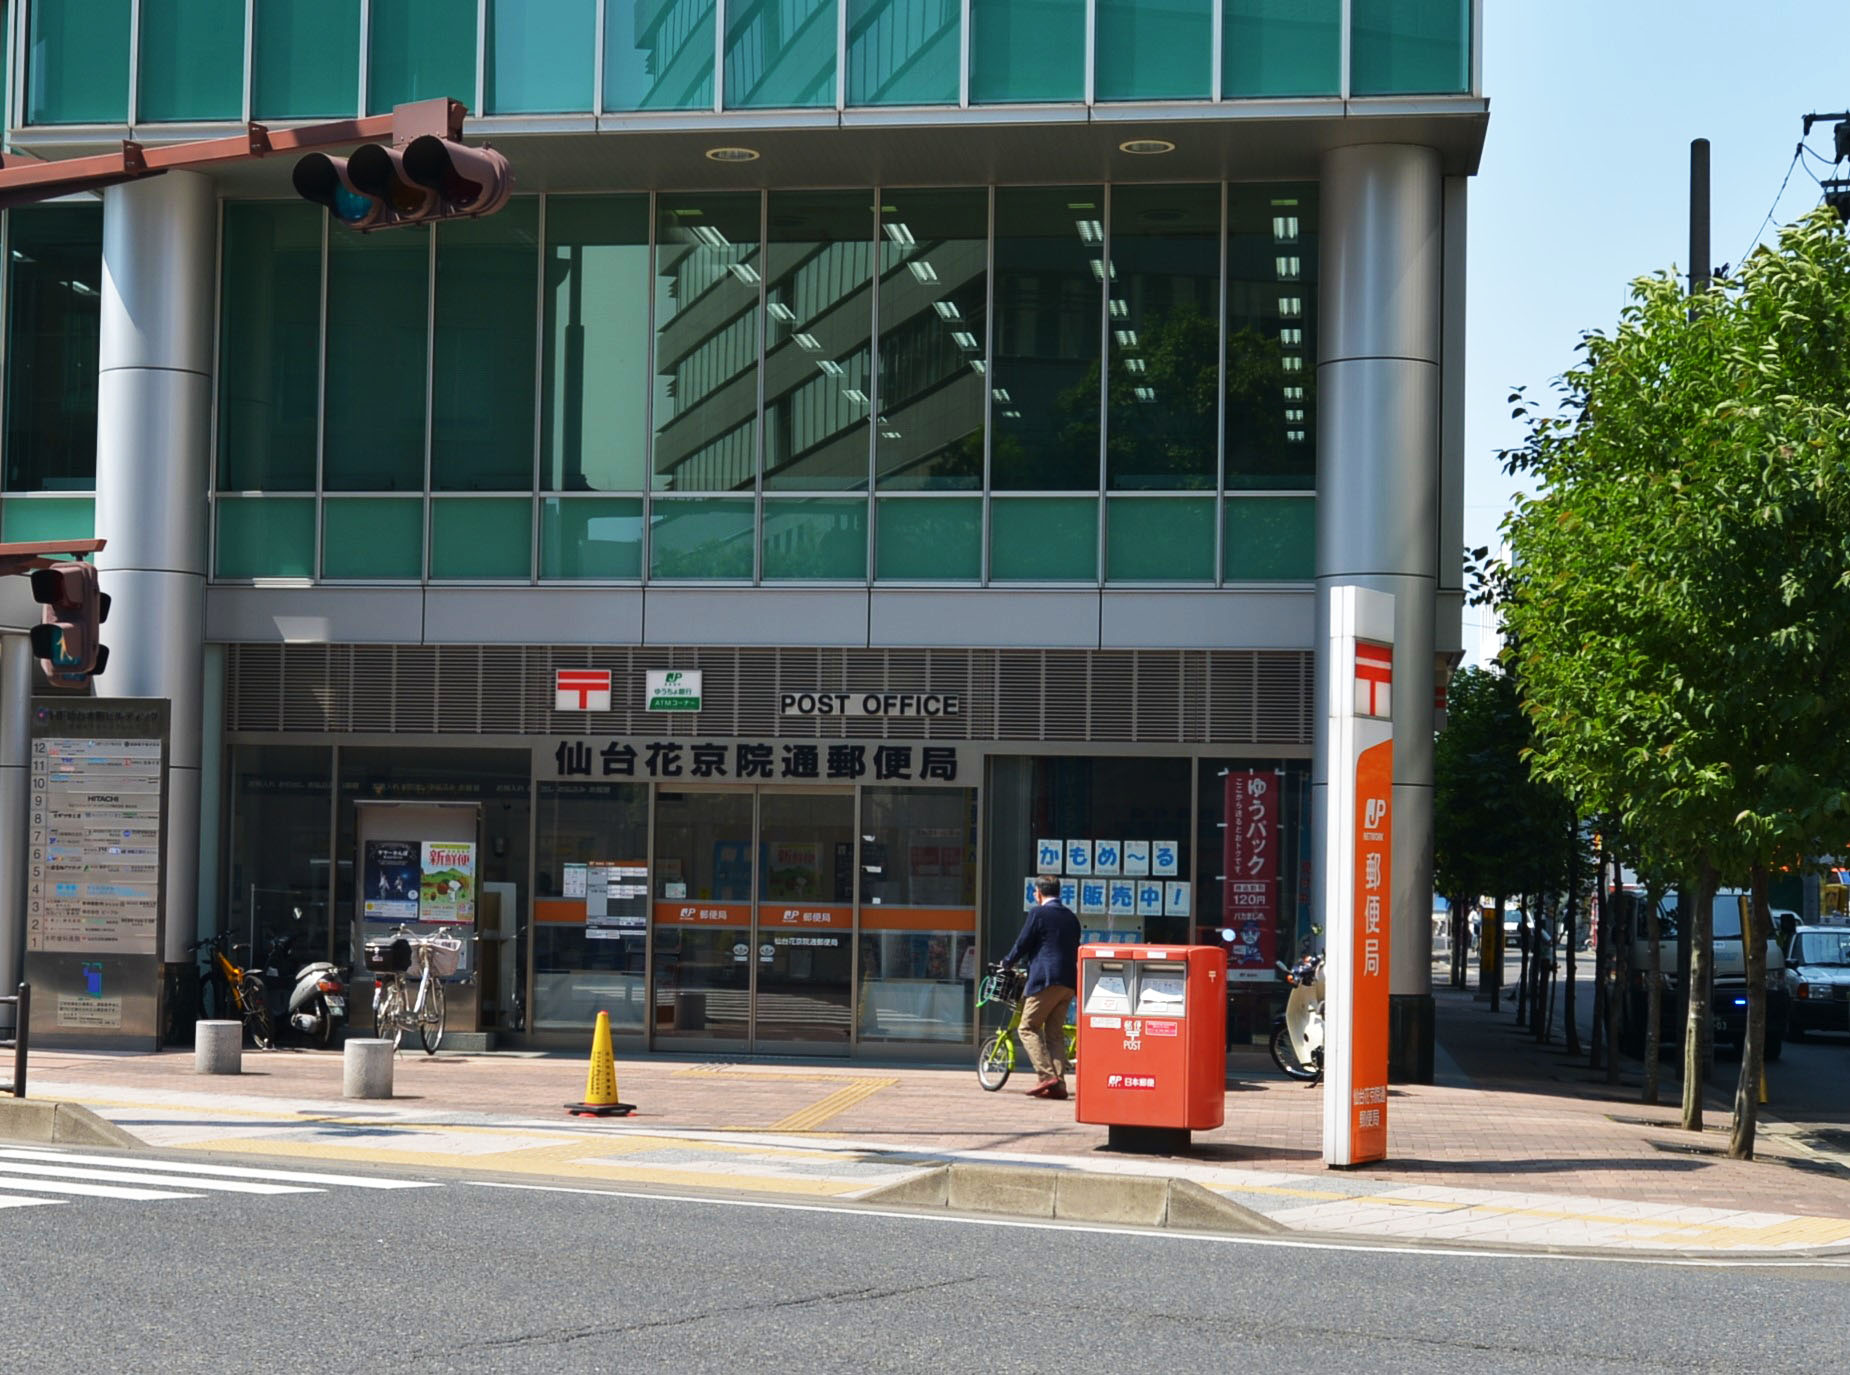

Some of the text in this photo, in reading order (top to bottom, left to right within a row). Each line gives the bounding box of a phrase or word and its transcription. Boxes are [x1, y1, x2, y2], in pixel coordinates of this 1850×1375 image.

[665, 672, 683, 683] JP
[654, 687, 692, 696] ゆうちょ銀行
[655, 699, 695, 707] ATMコーナー
[780, 694, 958, 716] POST OFFICE
[34, 742, 46, 754] 12
[33, 760, 45, 772] 11
[555, 740, 958, 782] 仙台花京院通郵便局
[33, 778, 45, 789] 10
[34, 795, 42, 807] 9
[34, 813, 42, 824] 8
[1364, 798, 1387, 829] JP
[1247, 777, 1267, 876] ゆうパック
[34, 830, 42, 842] 7
[33, 848, 41, 859] 6
[32, 865, 41, 877] 5
[32, 883, 40, 895] 4
[1233, 894, 1265, 905] 120円
[32, 901, 40, 912] 3
[700, 910, 728, 921] 郵便局
[803, 912, 832, 923] 郵便局
[1363, 851, 1382, 977] 郵便局
[32, 918, 40, 929] 2
[31, 937, 37, 948] 1
[1124, 1019, 1143, 1032] 郵便
[1123, 1039, 1142, 1051] POST
[1124, 1077, 1155, 1088] 日本郵便
